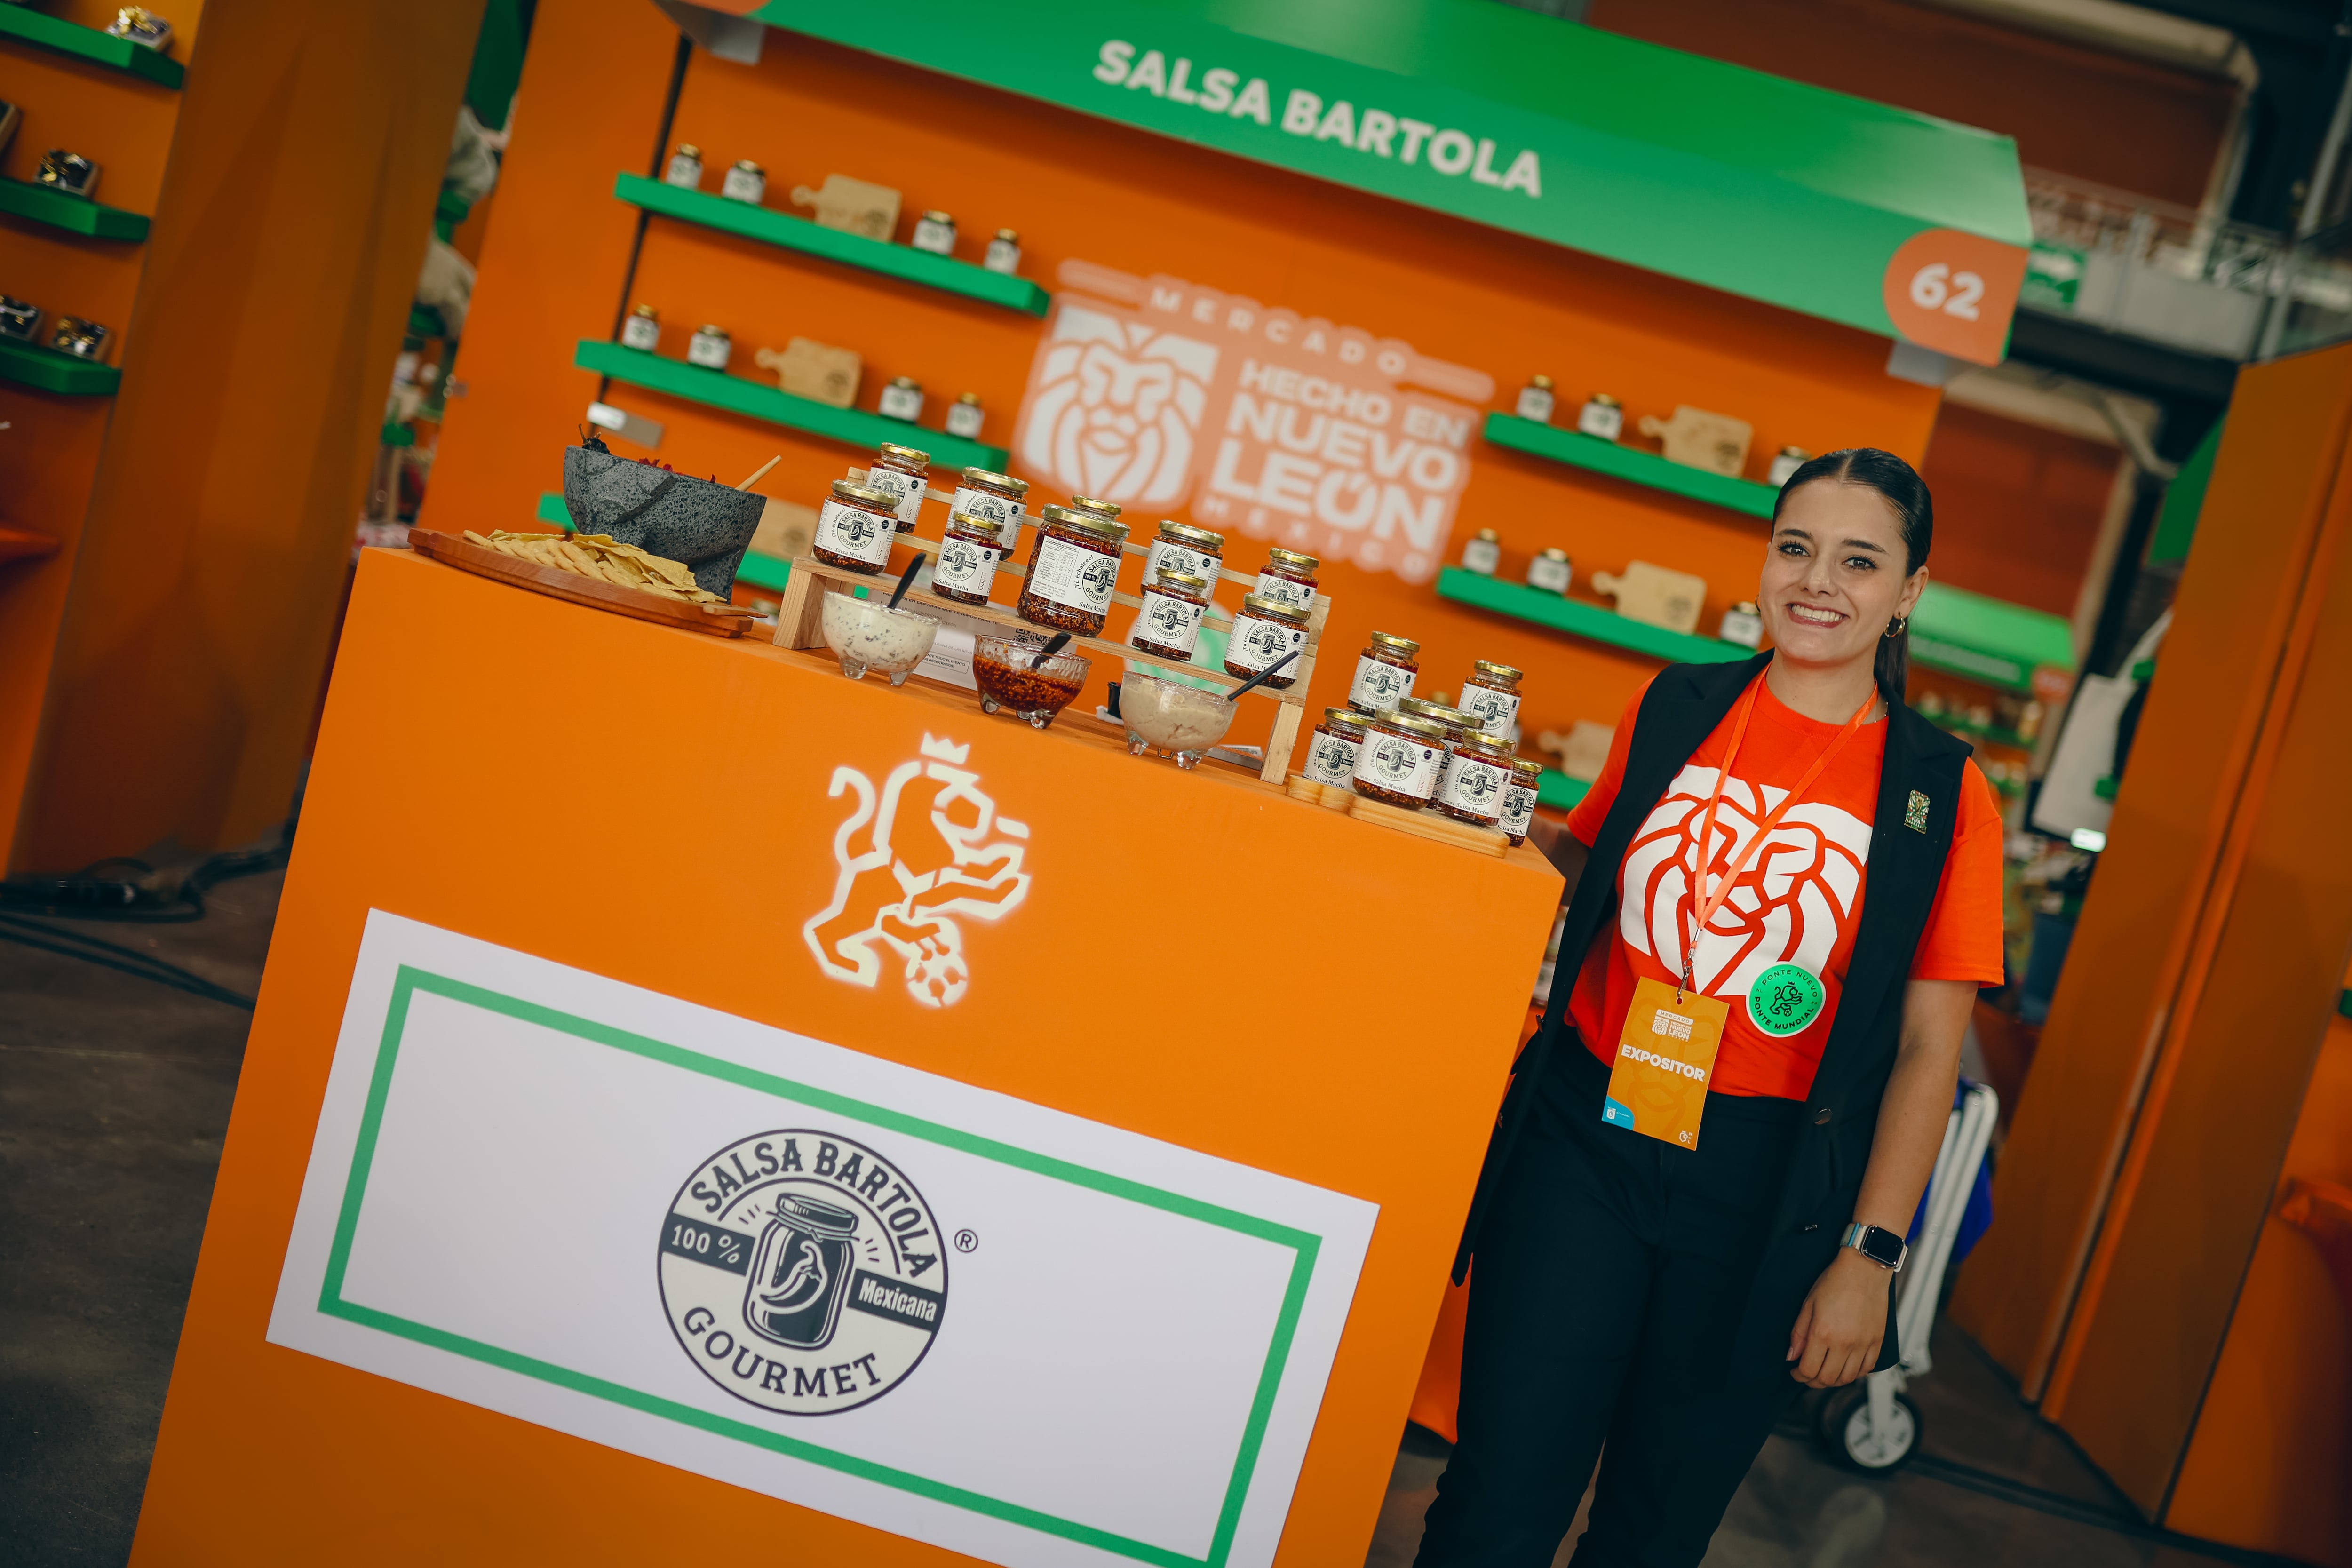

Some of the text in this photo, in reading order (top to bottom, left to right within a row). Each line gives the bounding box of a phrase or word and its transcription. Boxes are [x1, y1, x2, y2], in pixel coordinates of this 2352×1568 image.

[1092, 40, 1542, 199] SALSA BARTOLA
[1910, 263, 1985, 322] 62
[1150, 287, 1406, 373] MERCADO
[1238, 359, 1470, 448] HECHO EN
[1228, 393, 1456, 492] NUEVO
[874, 473, 887, 484] SALSA
[888, 473, 904, 491] BARTOLA
[1212, 441, 1445, 549] LEÓN
[973, 498, 988, 509] SALSA
[988, 499, 1004, 517] BARTOLA
[842, 511, 857, 523] SALSA
[858, 513, 874, 531] BARTOLA
[840, 535, 866, 548] GOURMET
[835, 547, 866, 560] Salsa Macha
[945, 543, 960, 555] SALSA
[960, 543, 976, 562] BARTOLA
[1164, 550, 1178, 560] SALSA
[1179, 550, 1194, 568] BARTOLA
[943, 566, 969, 579] GOURMET
[1076, 555, 1093, 580] échaleee!
[1088, 560, 1104, 573] SALSA
[938, 578, 969, 591] Salsa Macha
[1267, 581, 1281, 591] SALSA
[1282, 581, 1298, 599] BARTOLA
[1086, 587, 1109, 601] GOURMET
[1079, 601, 1105, 613] Salsa Macha
[1156, 601, 1188, 620] SALSA BARTOLA
[1154, 624, 1181, 637] GOURMET
[1253, 625, 1268, 637] SALSA
[1269, 627, 1285, 645] BARTOLA
[1148, 636, 1180, 649] Salsa Macha
[1251, 649, 1279, 661] GOURMET
[1247, 661, 1259, 669] Salsa
[1369, 667, 1399, 685] SALSA BARTOLA
[1366, 688, 1392, 700] GOURMET
[1477, 694, 1508, 711] SALSA BARTOLA
[1361, 699, 1374, 708] Salsa
[1321, 741, 1353, 760] SALSA BARTOLA
[1381, 741, 1396, 752] SALSA
[1398, 742, 1415, 762] BARTOLA
[1319, 763, 1346, 776] GOURMET
[1378, 765, 1406, 779] GOURMET
[1464, 767, 1498, 785] SALSA BARTOLA
[1328, 780, 1345, 789] Macha
[1373, 778, 1406, 792] Salsa Macha
[1462, 789, 1490, 803] GOURMET
[1505, 790, 1519, 800] SALSA
[1520, 789, 1533, 806] BARTOLA
[1471, 807, 1489, 816] Macha
[1502, 812, 1526, 823] GOURMET
[1762, 970, 1818, 997] PONTE NUEVO
[1660, 1011, 1690, 1023] MERCADO
[1755, 996, 1814, 1030] PONTE MUNDIAL
[1668, 1028, 1690, 1040] LEÓN
[1669, 1024, 1691, 1034] NUEVO
[1621, 1044, 1705, 1082] EXPOSITOR
[691, 1138, 938, 1278] SALSA BARTOLA
[671, 1225, 741, 1264] 100 %
[858, 1278, 938, 1322] Mexicana
[683, 1306, 881, 1398] GOURMET
